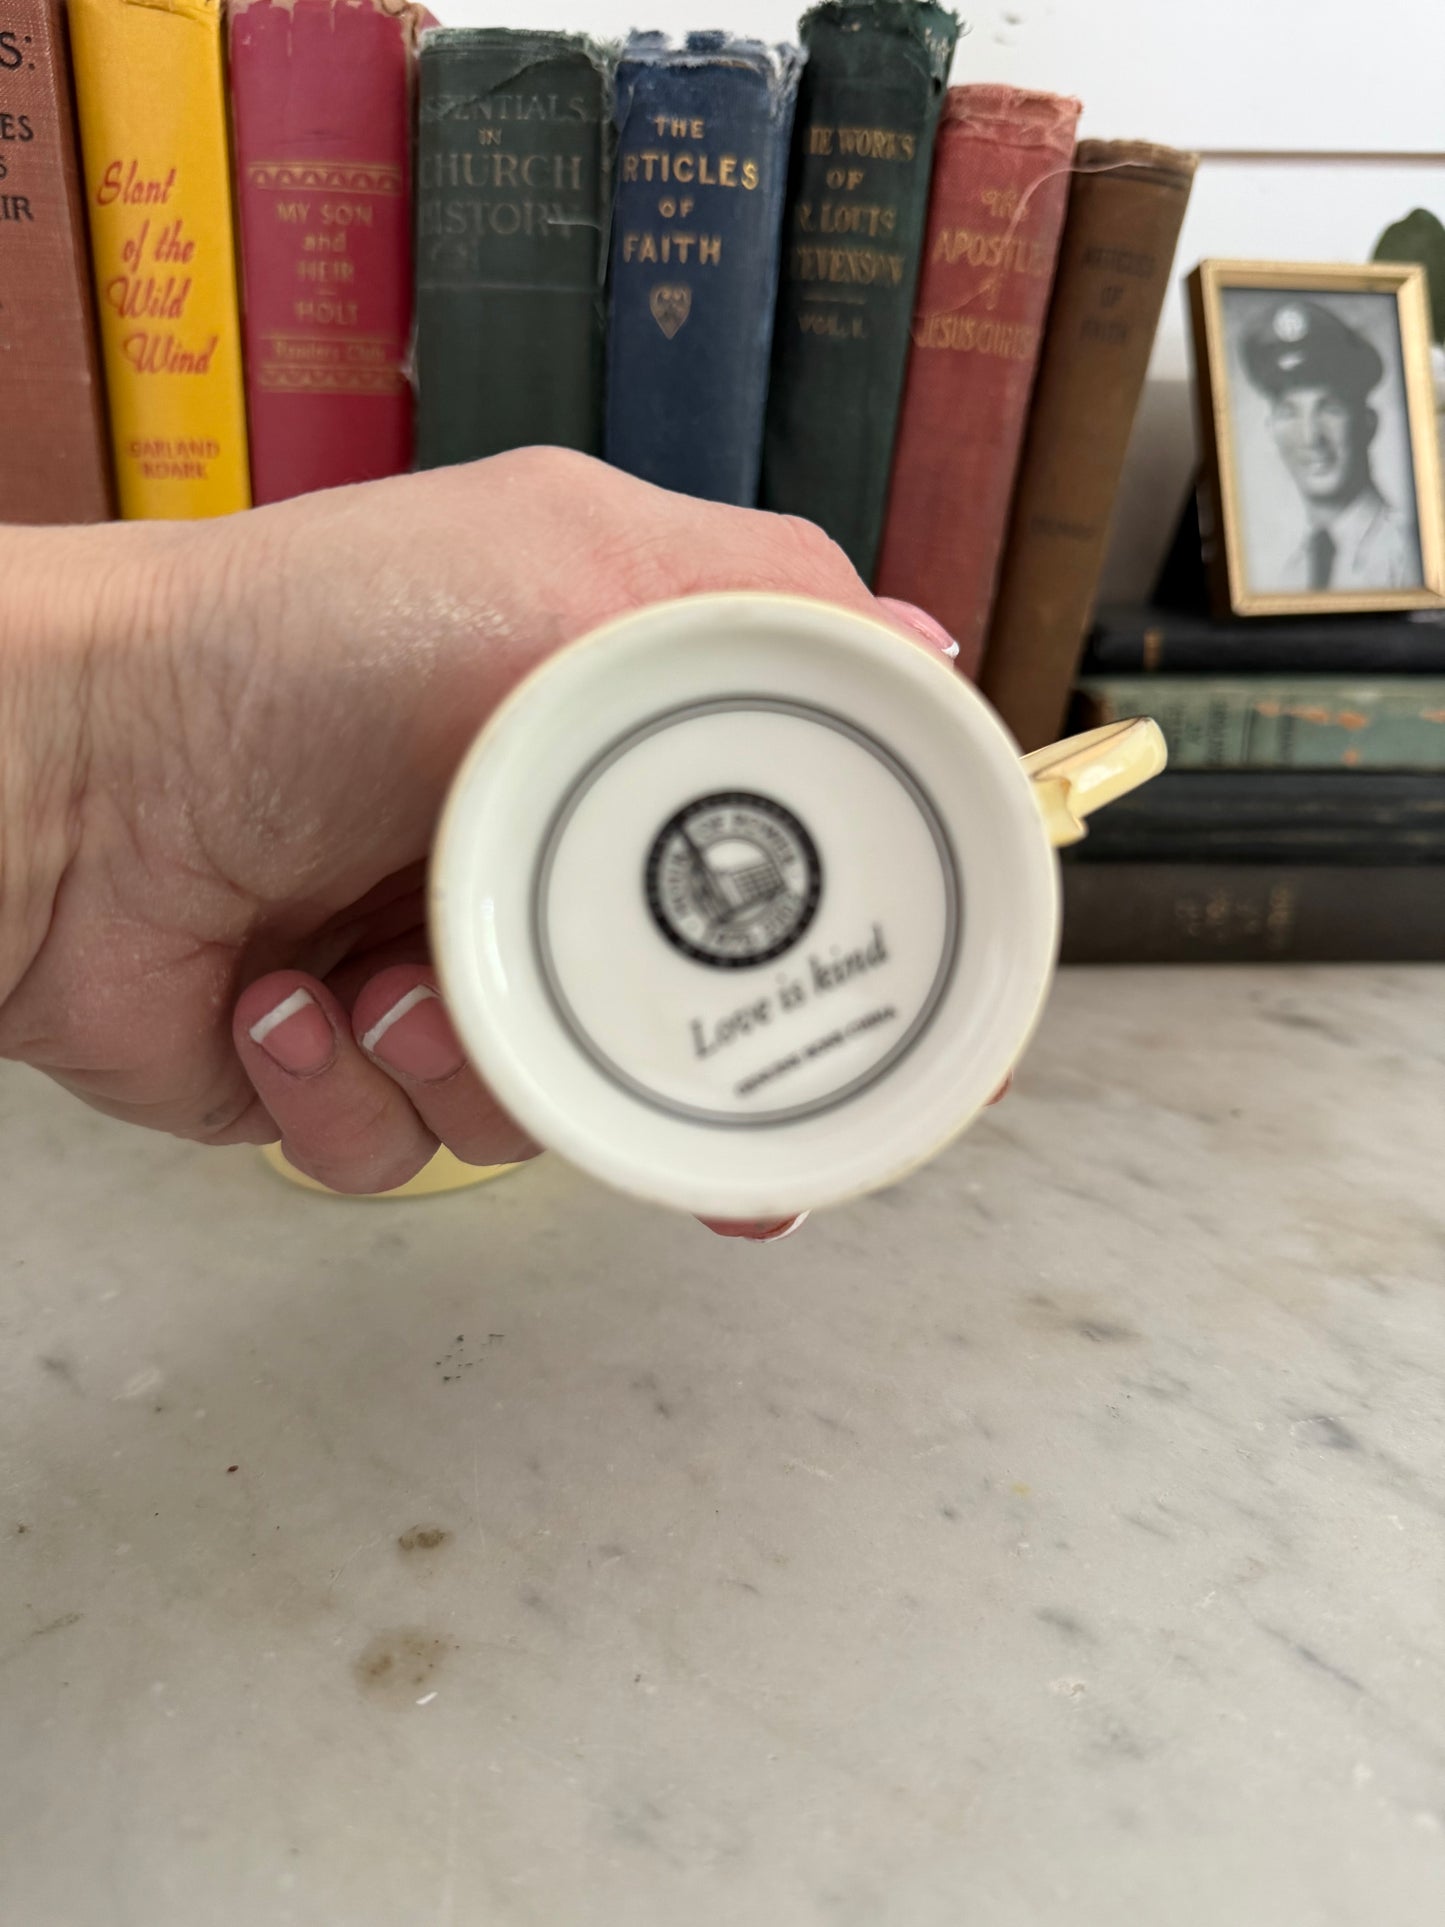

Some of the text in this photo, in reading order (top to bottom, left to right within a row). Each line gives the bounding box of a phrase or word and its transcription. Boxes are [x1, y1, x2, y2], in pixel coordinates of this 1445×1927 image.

[654, 115, 704, 139] THE
[837, 127, 916, 162] WORKS
[97, 160, 176, 206] Slant
[623, 152, 760, 191] RTICLES
[826, 168, 864, 190] OF
[276, 202, 374, 226] MY SON
[420, 199, 581, 239] ISTORY
[658, 197, 695, 218] OF
[121, 219, 195, 272] of the
[304, 232, 347, 251] and
[623, 233, 722, 265] FAITH
[107, 276, 192, 318] Wild
[123, 333, 218, 374] Wind
[690, 921, 888, 1059] Love is kind
